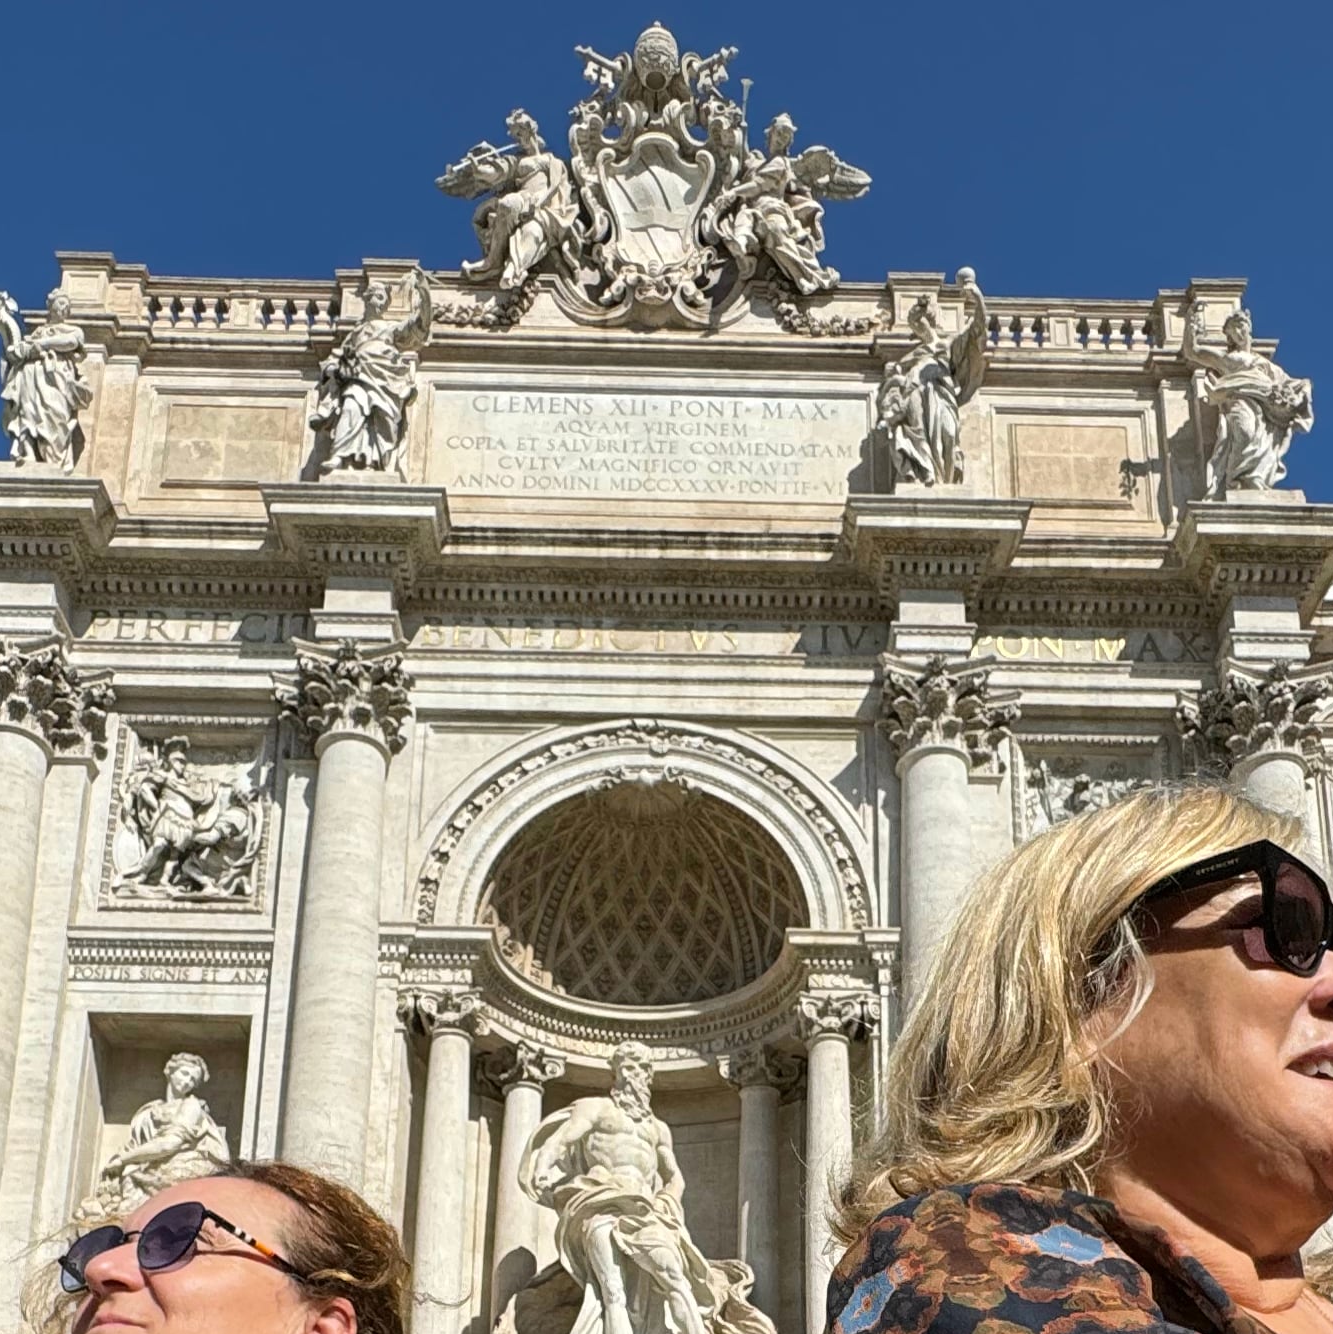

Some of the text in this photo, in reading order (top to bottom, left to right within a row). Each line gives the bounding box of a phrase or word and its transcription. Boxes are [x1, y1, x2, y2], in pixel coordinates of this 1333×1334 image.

[472, 395, 594, 416] CLEMENS
[554, 420, 748, 438] AQVAM VIRGINEM
[446, 436, 853, 458] COPIA ET SALVBRITATE COMMENDATAM
[498, 456, 803, 476] CVLTV MAGNIFICO ORNAVIT
[452, 474, 515, 489] ANNO
[522, 475, 600, 491] DOMINI
[86, 609, 311, 644] PERFECIT
[421, 616, 739, 653] BENEDICTVS
[73, 966, 131, 980] POSITIS
[140, 967, 190, 981] SIGNIS
[201, 968, 219, 982] ET
